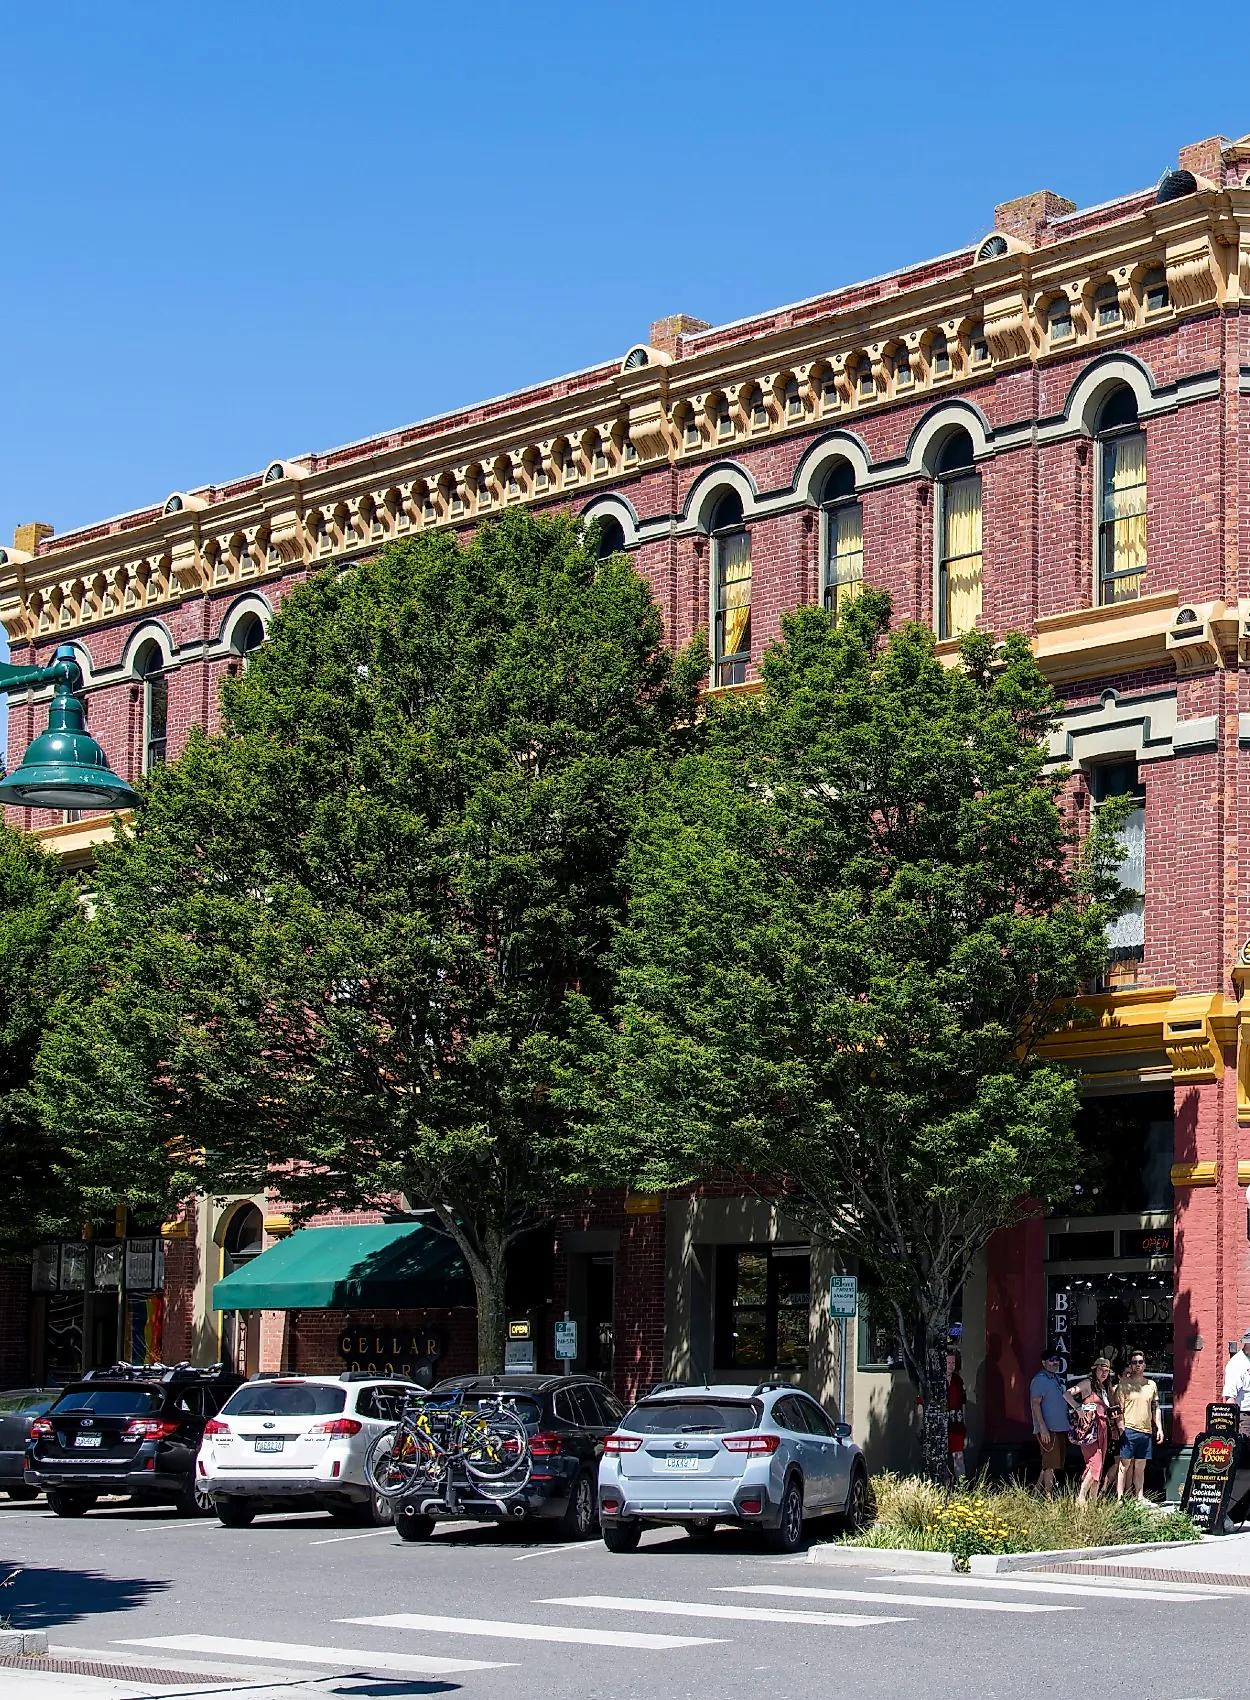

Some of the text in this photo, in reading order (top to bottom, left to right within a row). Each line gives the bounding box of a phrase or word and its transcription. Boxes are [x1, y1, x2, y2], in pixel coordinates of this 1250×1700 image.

[1142, 1237, 1170, 1249] OPEN
[833, 1278, 840, 1287] 15
[511, 1325, 528, 1334] OPEN
[558, 1323, 564, 1332] 2
[342, 1337, 437, 1355] CELLAR
[1202, 1447, 1230, 1456] CELLAR
[1204, 1453, 1225, 1463] DOOR
